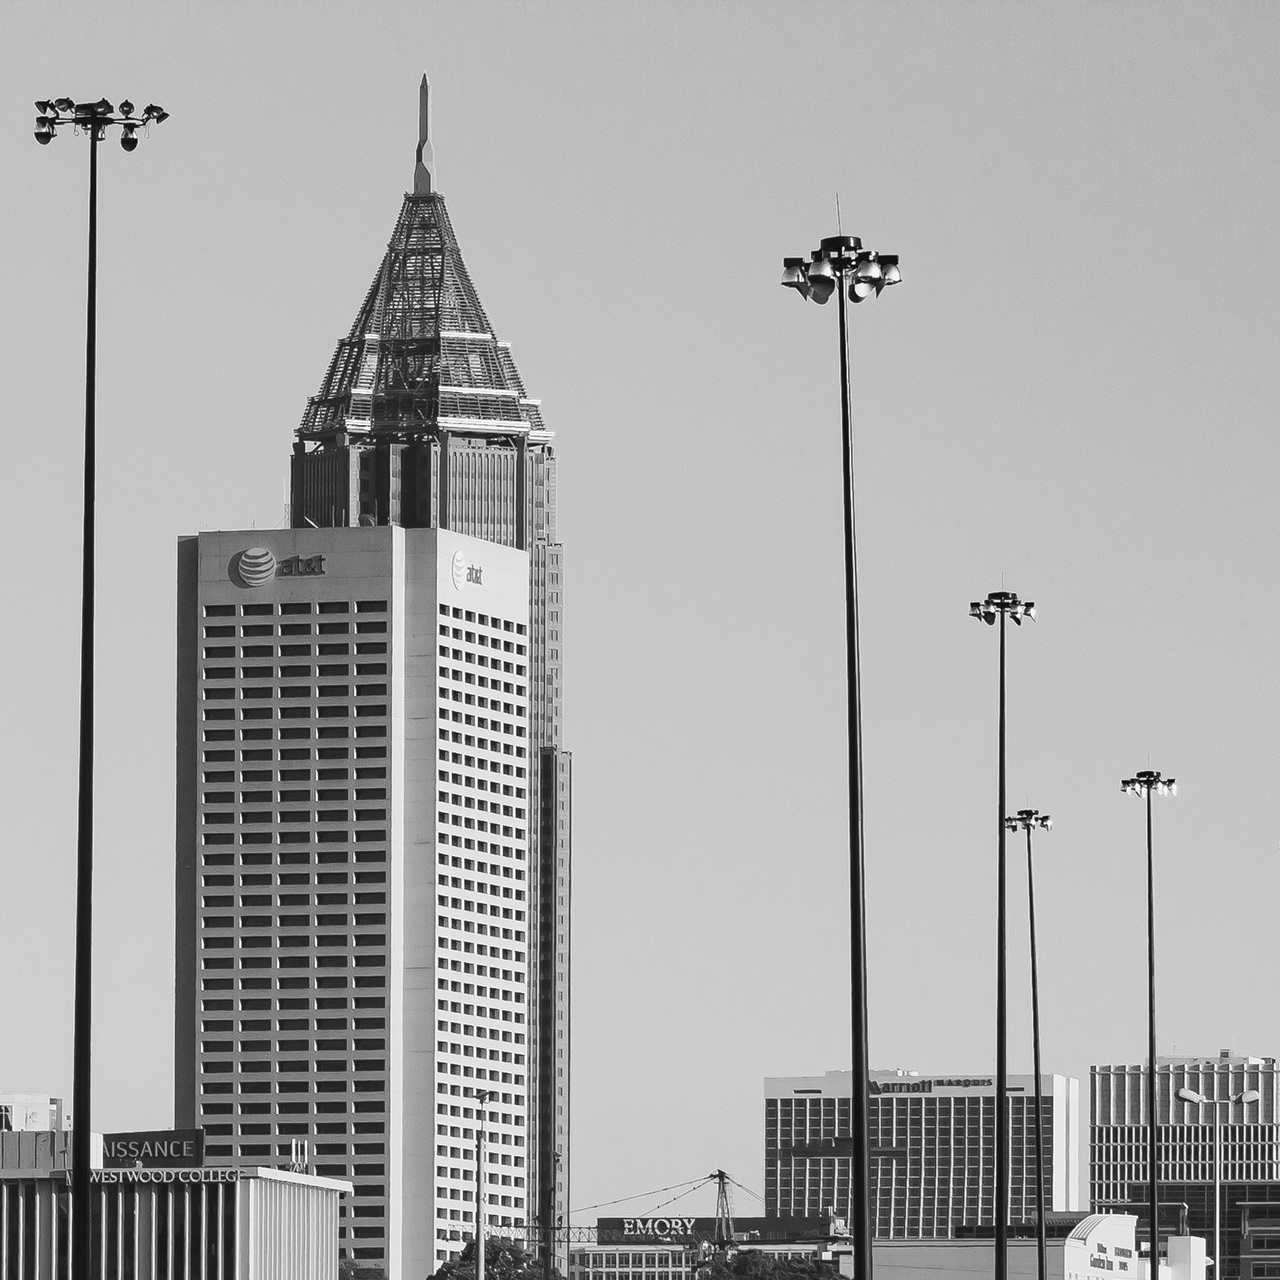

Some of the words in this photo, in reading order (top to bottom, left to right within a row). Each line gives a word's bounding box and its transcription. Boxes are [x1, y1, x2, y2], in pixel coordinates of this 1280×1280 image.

[281, 554, 326, 575] at&t
[466, 563, 483, 586] at&t
[623, 1218, 696, 1235] EMORY
